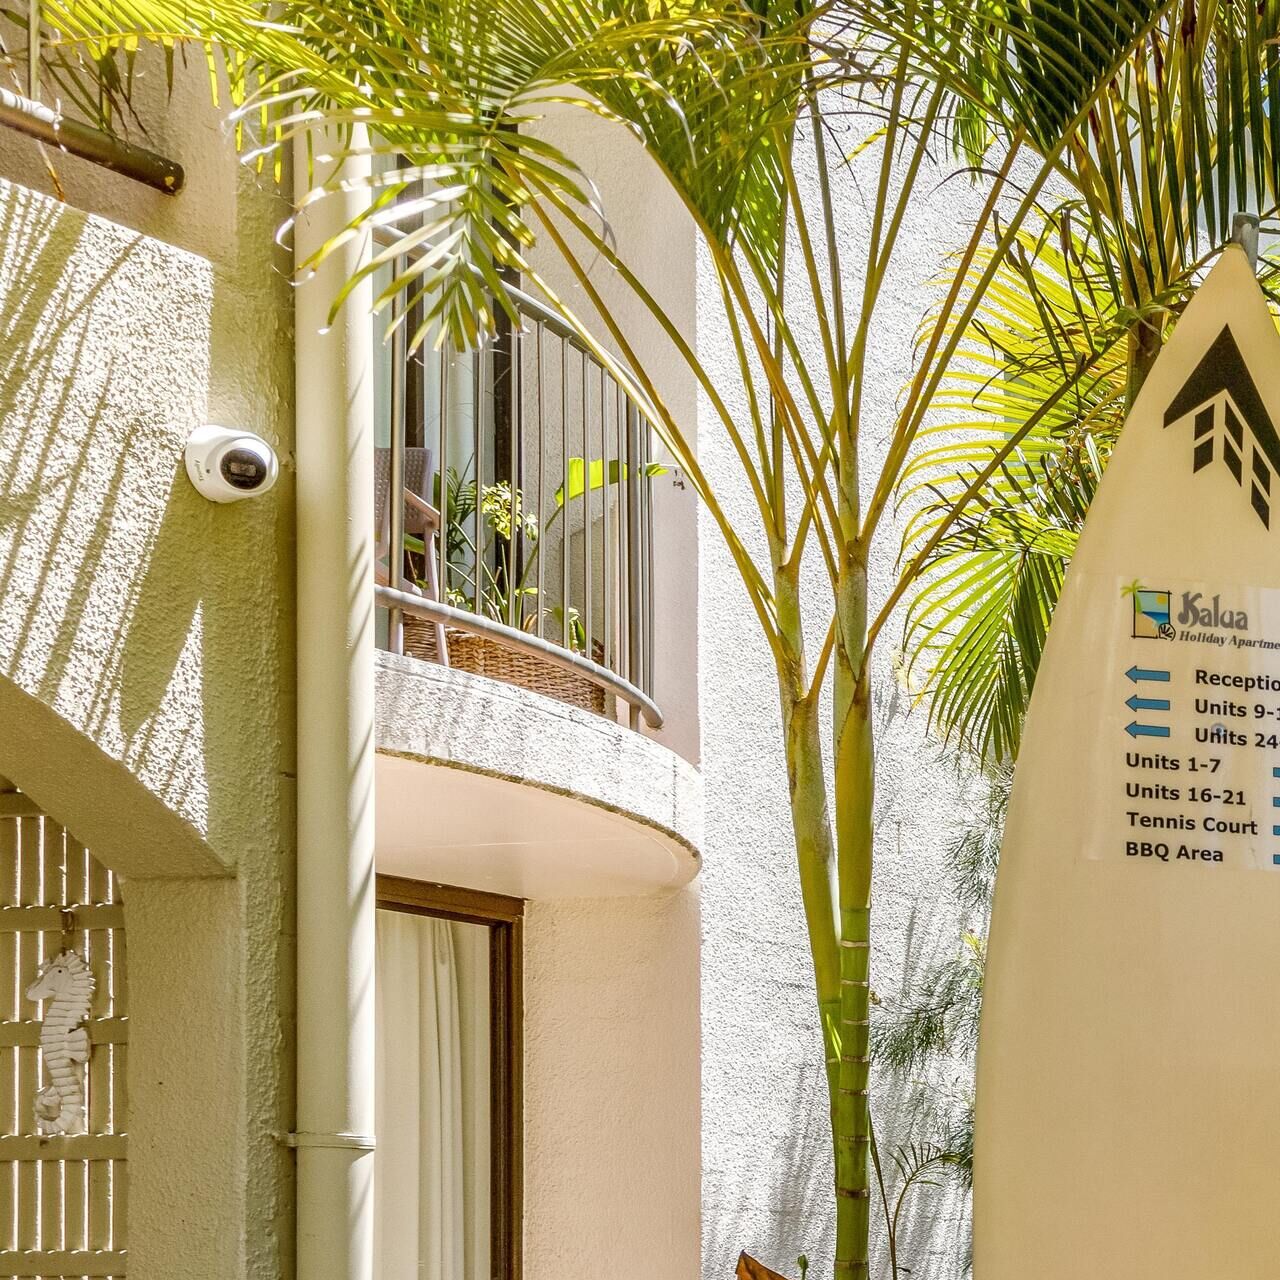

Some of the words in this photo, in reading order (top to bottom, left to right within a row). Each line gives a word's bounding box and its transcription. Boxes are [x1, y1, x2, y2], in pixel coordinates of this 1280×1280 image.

[1177, 591, 1248, 630] Kalua
[1179, 631, 1227, 647] Holiday
[1195, 699, 1247, 717] Units
[1195, 728, 1247, 746] Units
[1126, 752, 1180, 770] Units
[1188, 757, 1221, 773] 1-7
[1126, 782, 1180, 800] Units
[1188, 787, 1246, 806] 16-21
[1126, 811, 1196, 830] Tennis
[1203, 817, 1258, 835] Court
[1126, 841, 1169, 862] BBQ
[1176, 845, 1224, 862] Area
